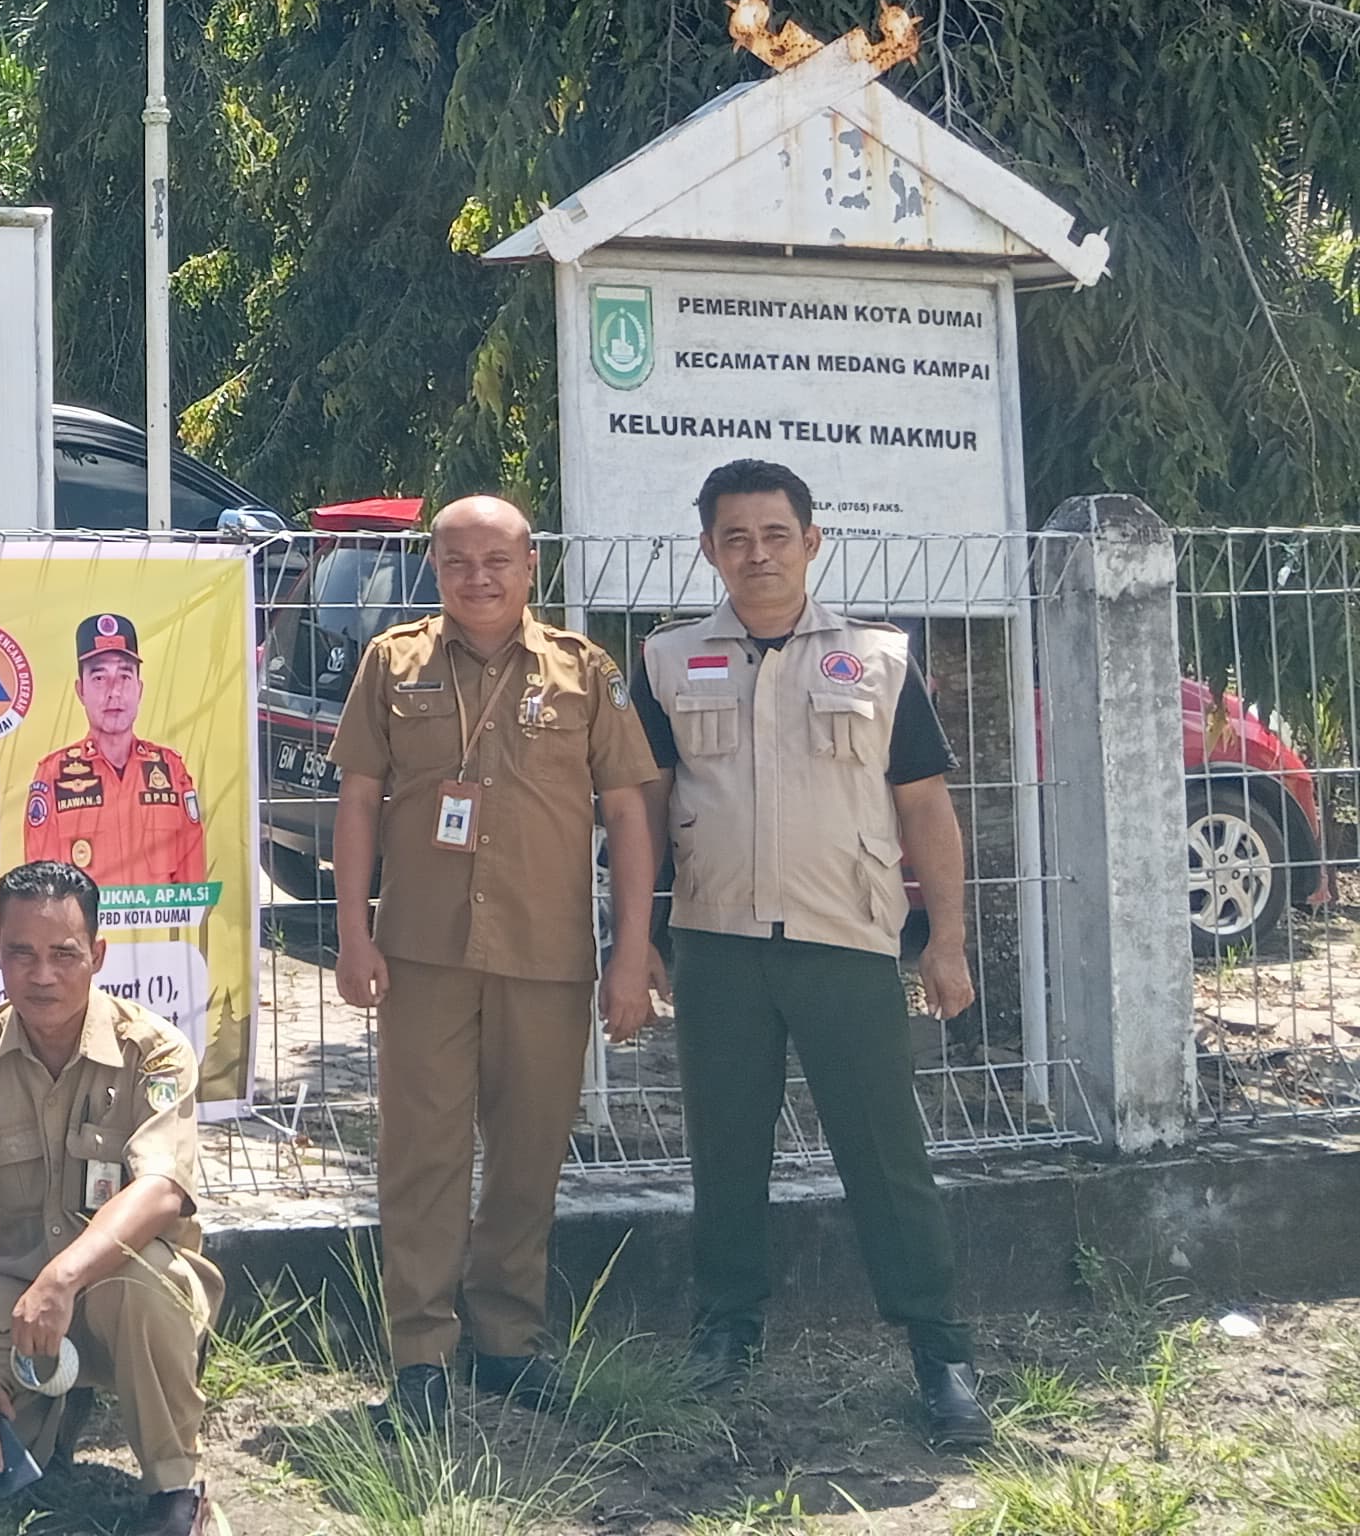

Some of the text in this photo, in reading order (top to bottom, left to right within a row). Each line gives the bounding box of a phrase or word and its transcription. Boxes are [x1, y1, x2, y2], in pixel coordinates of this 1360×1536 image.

[677, 296, 982, 329] PEMERINTAHAN KOTA DUMAI
[675, 351, 990, 381] KECAMATAN MEDANG KAMPAI
[609, 413, 977, 452] KELURAHAN TELUK MAKMUR
[811, 501, 904, 513] ELP. (0765) FAKS.
[822, 527, 843, 536] OTA
[99, 886, 210, 906] UKMA, AP.M.Si
[98, 908, 192, 925] PBD KOTA DUMAI
[147, 975, 179, 1005] (1),
